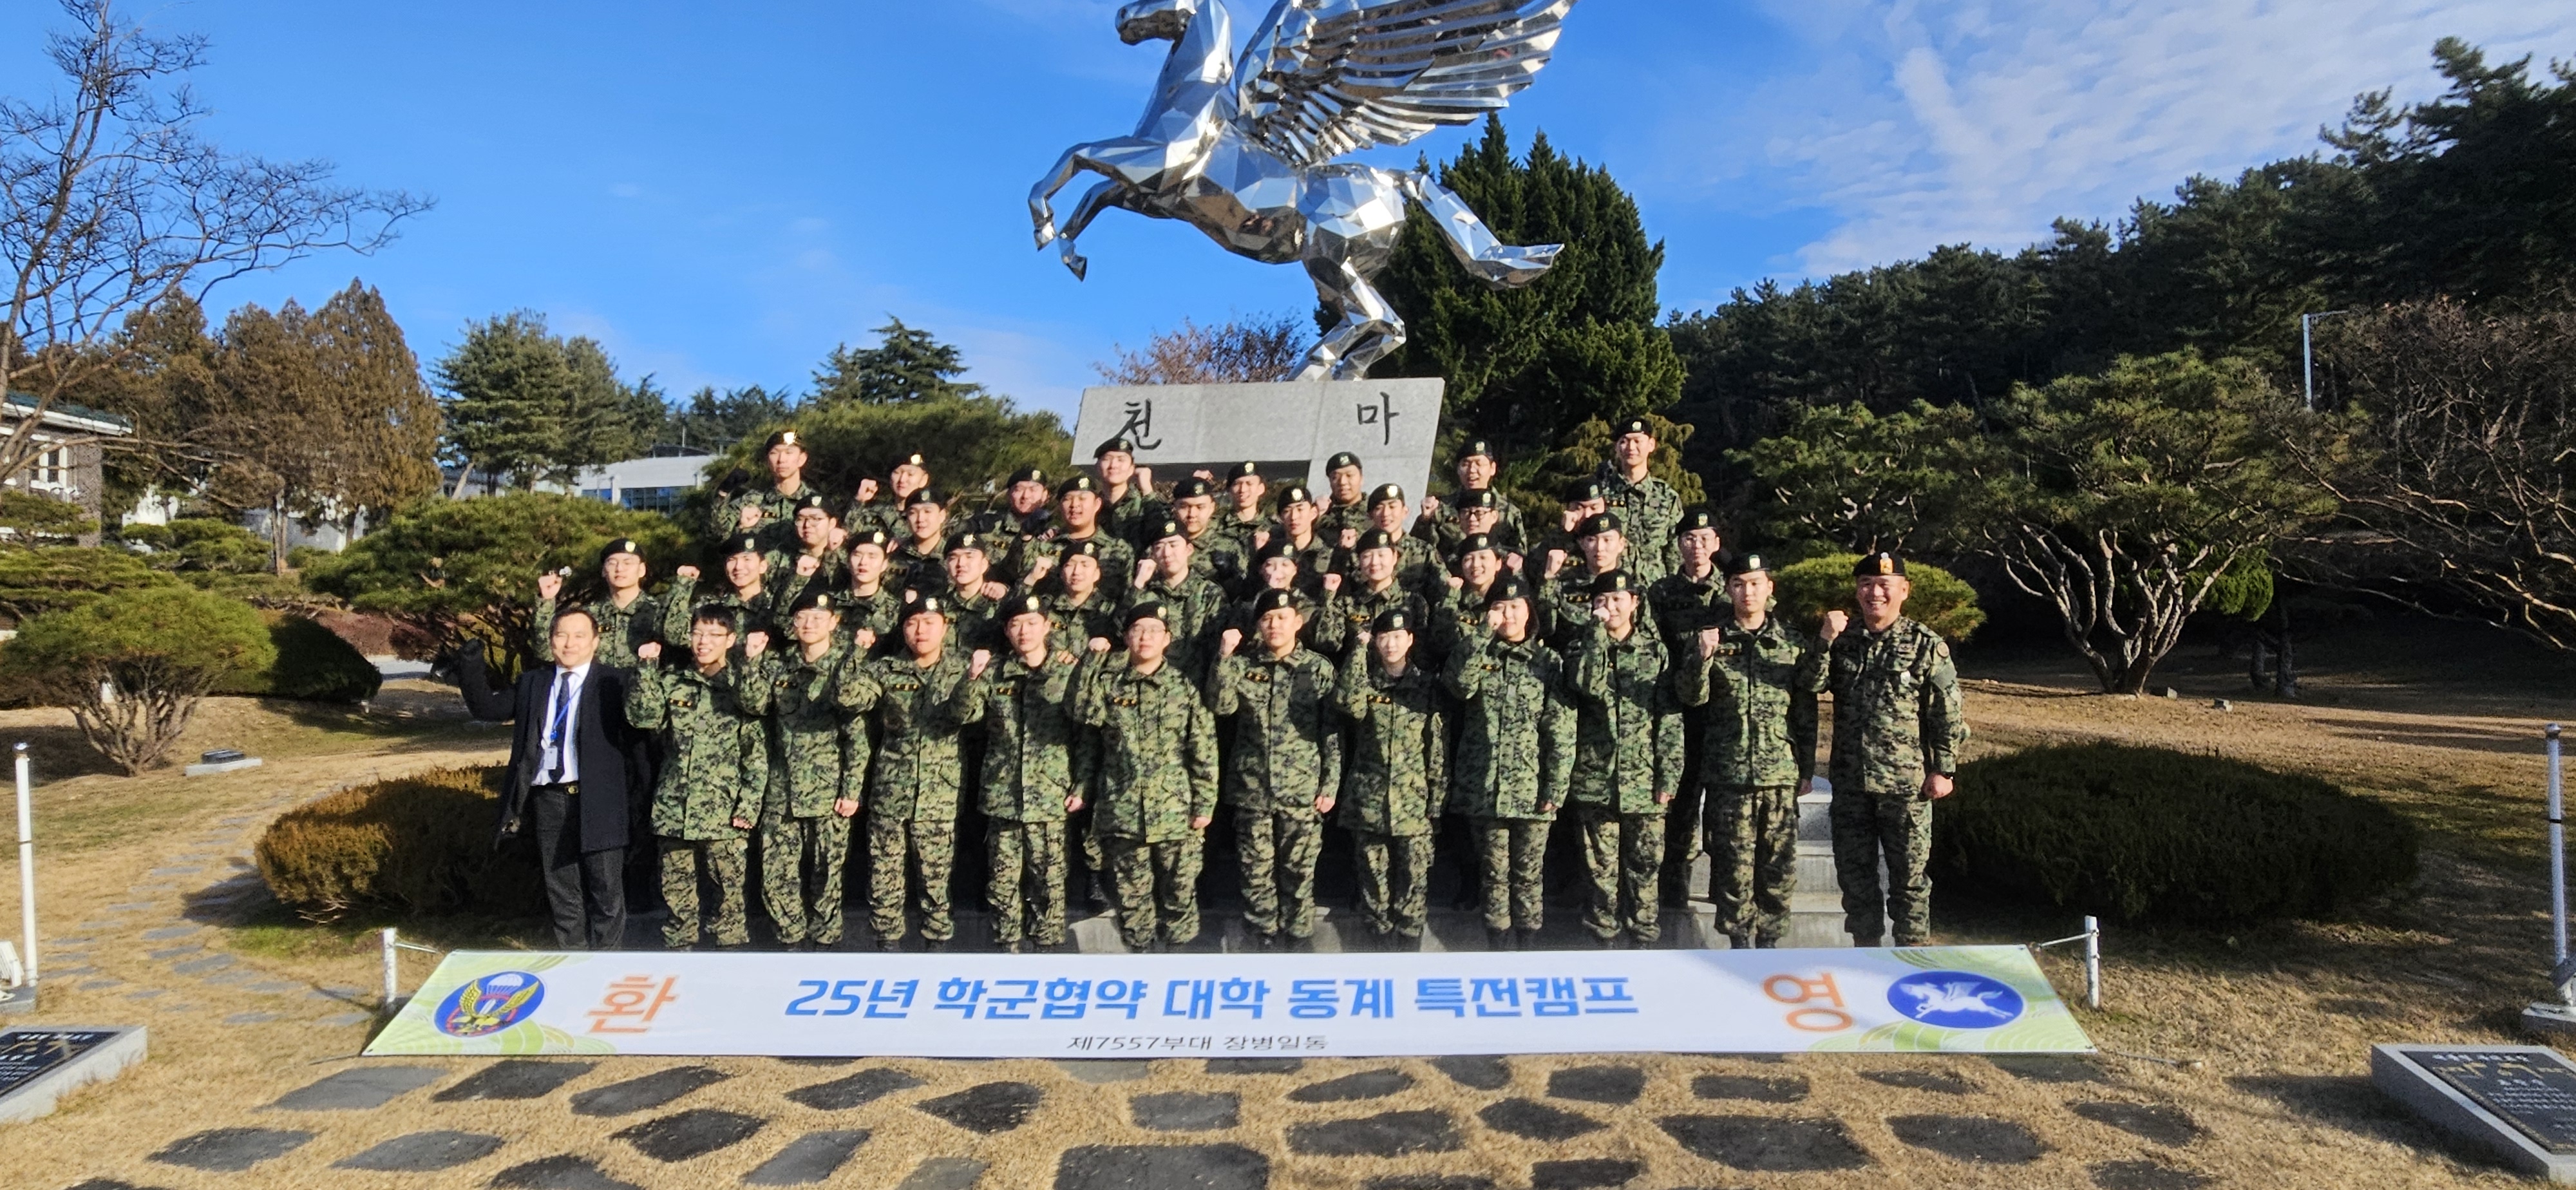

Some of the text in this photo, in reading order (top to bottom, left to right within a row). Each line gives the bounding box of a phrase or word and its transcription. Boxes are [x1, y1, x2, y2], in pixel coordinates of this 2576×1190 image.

[1113, 392, 1400, 451] 천 마
[585, 974, 678, 1034] 환
[784, 976, 1639, 1020] 25년 학군협약 대학 동계 특전캠프
[1762, 970, 1853, 1032] 영
[1067, 1035, 1329, 1052] 제7557부대 장병일동
